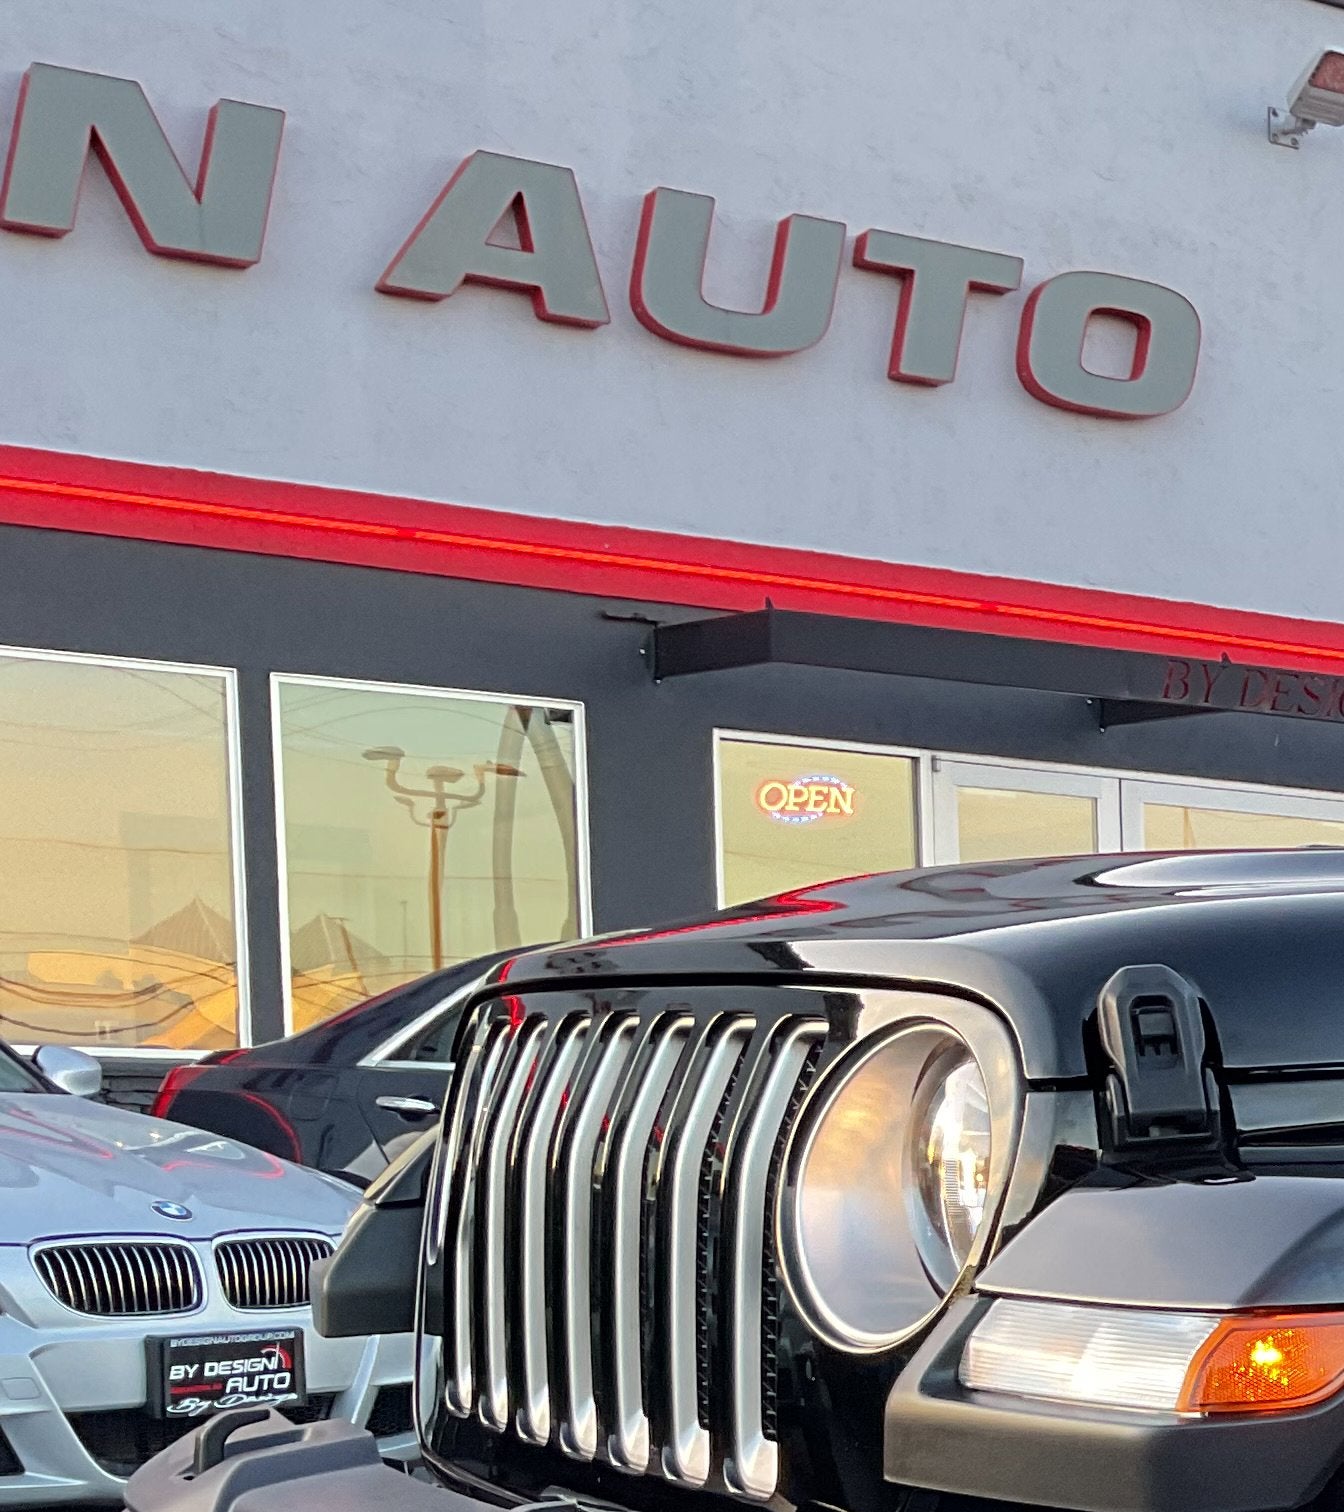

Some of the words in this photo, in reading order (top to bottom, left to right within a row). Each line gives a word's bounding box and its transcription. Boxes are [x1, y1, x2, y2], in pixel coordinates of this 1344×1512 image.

[374, 149, 1203, 420] AUTO
[1161, 659, 1223, 705] BY
[760, 782, 856, 815] OPEN
[169, 1363, 200, 1381] BY
[203, 1356, 278, 1377] DESIGN
[225, 1372, 291, 1394] AUTO
